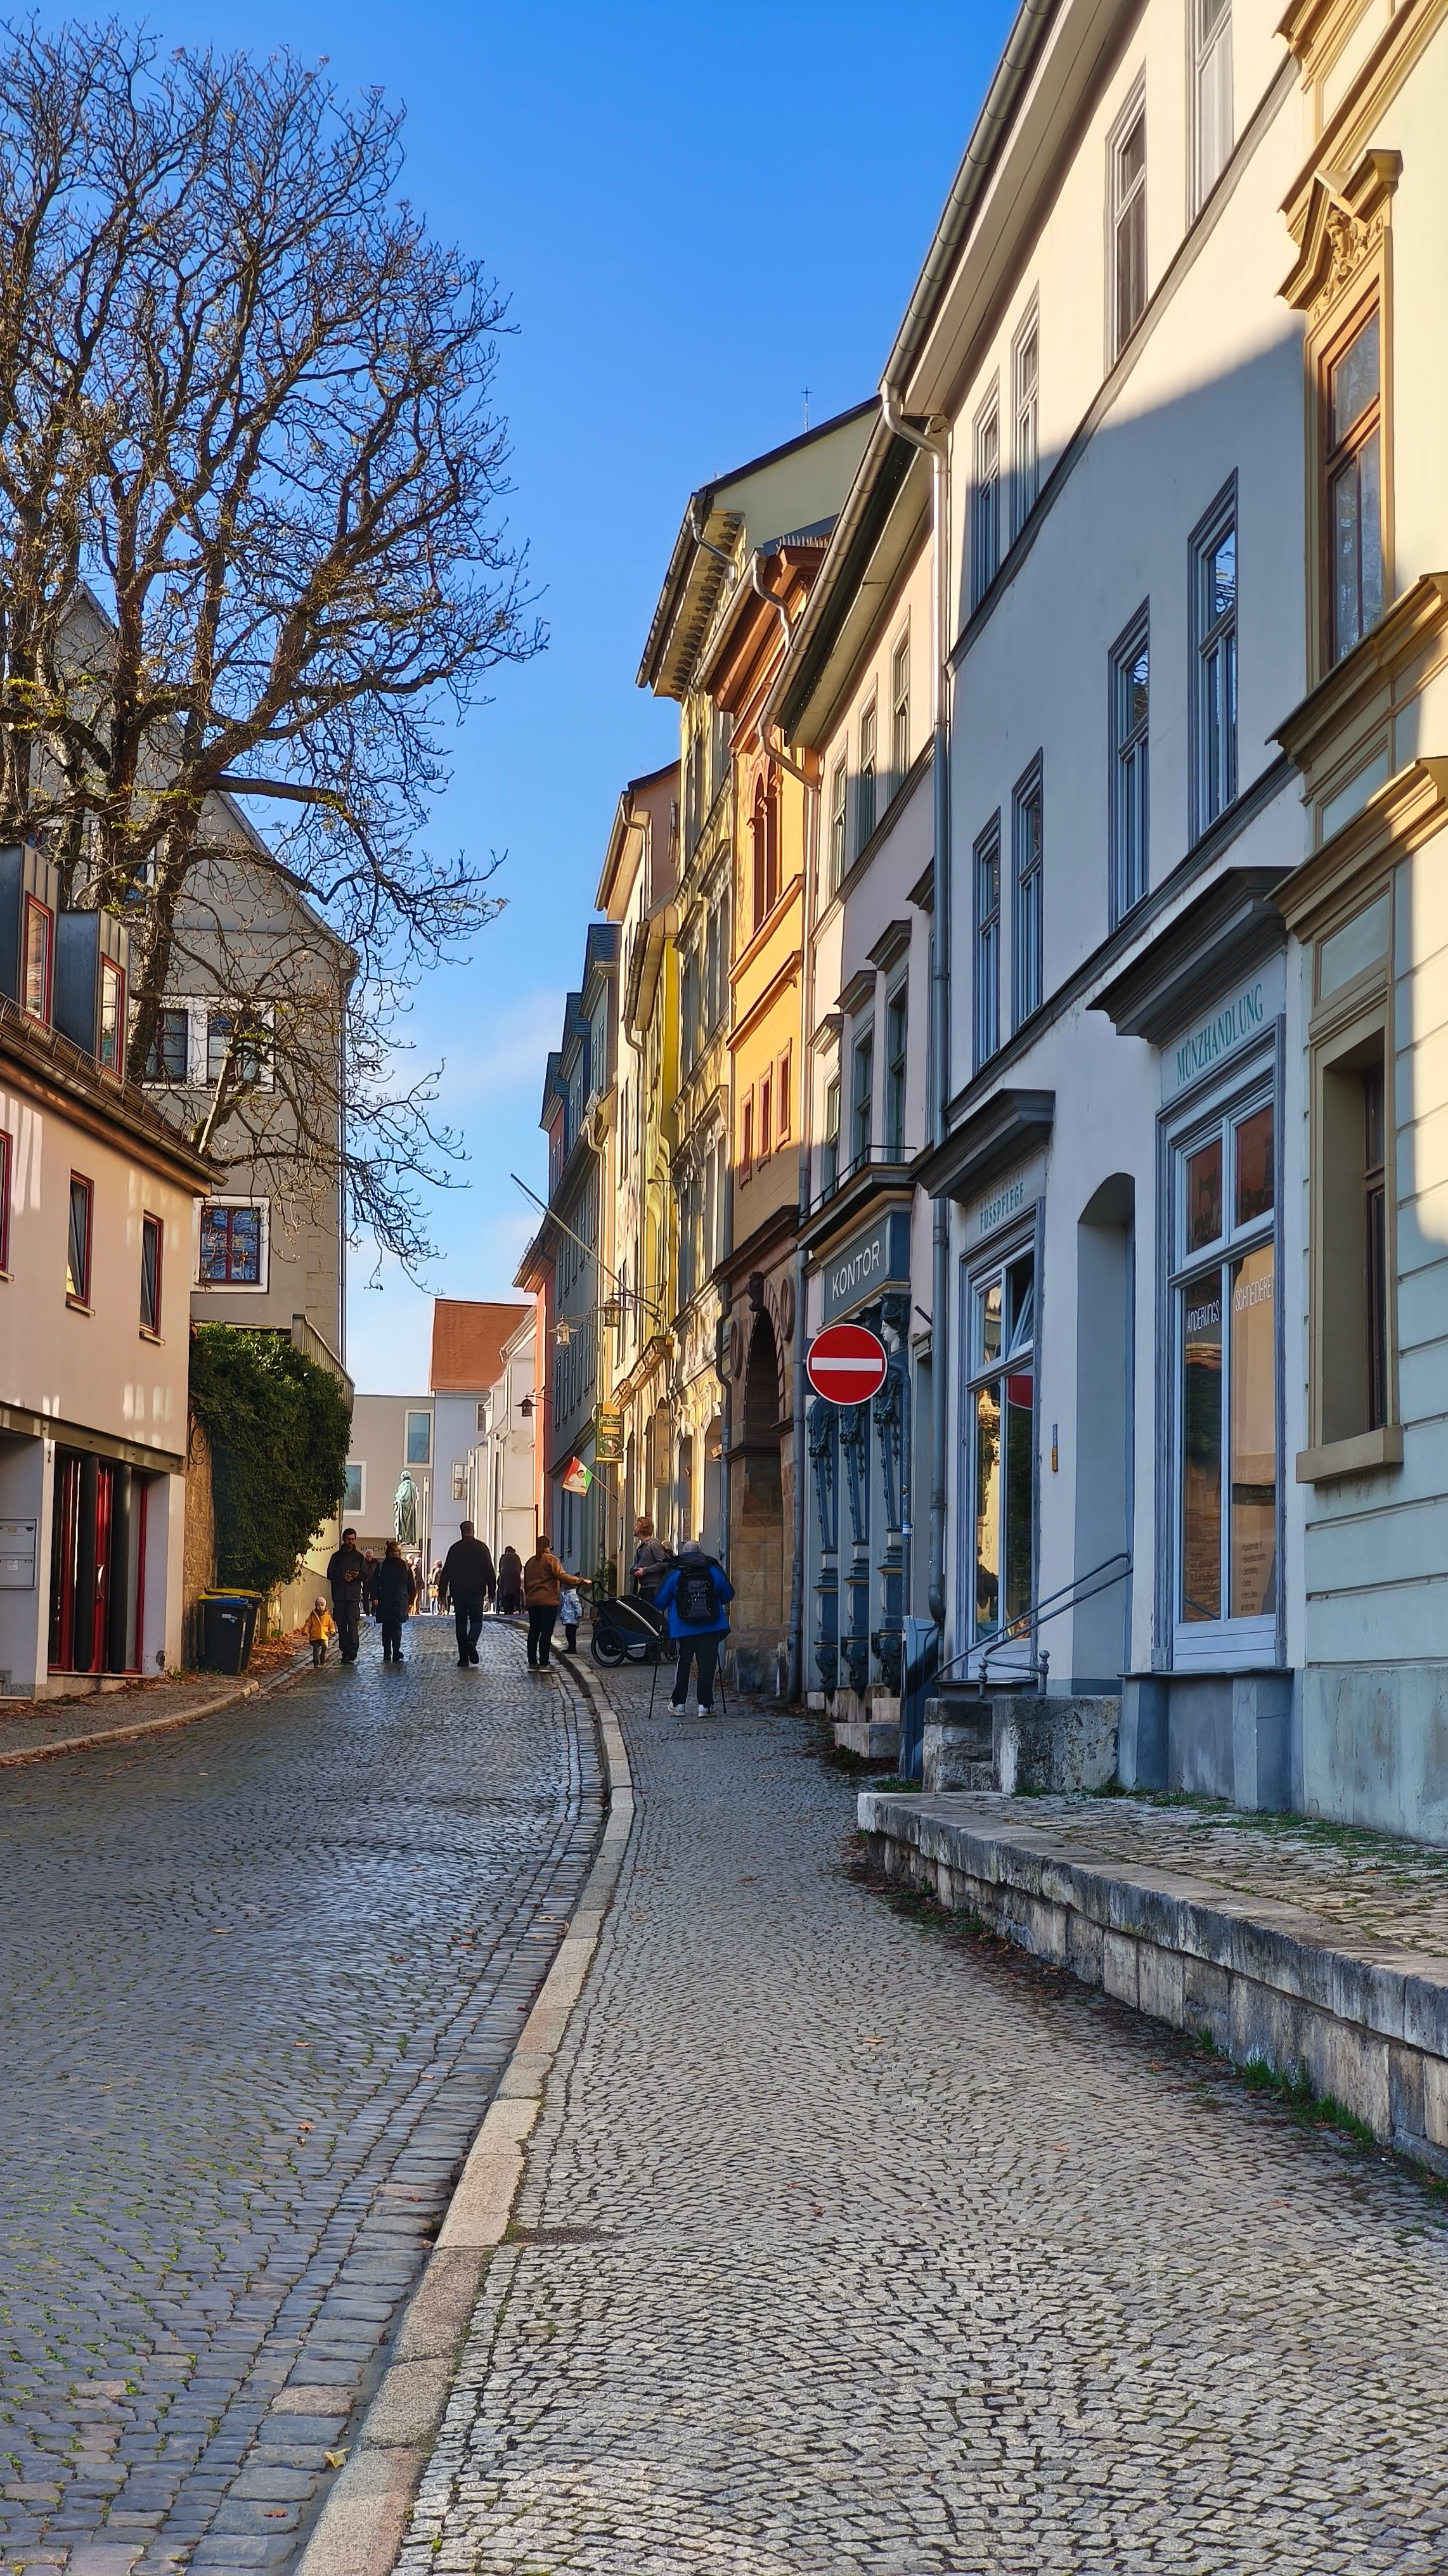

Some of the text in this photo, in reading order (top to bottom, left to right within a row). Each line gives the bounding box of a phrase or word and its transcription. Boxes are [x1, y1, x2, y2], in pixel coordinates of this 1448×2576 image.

[1176, 983, 1264, 1086] MÜNZHANDLUNG
[979, 1182, 1024, 1234] FUSSPFLEGE
[832, 1239, 881, 1302] KONTOR
